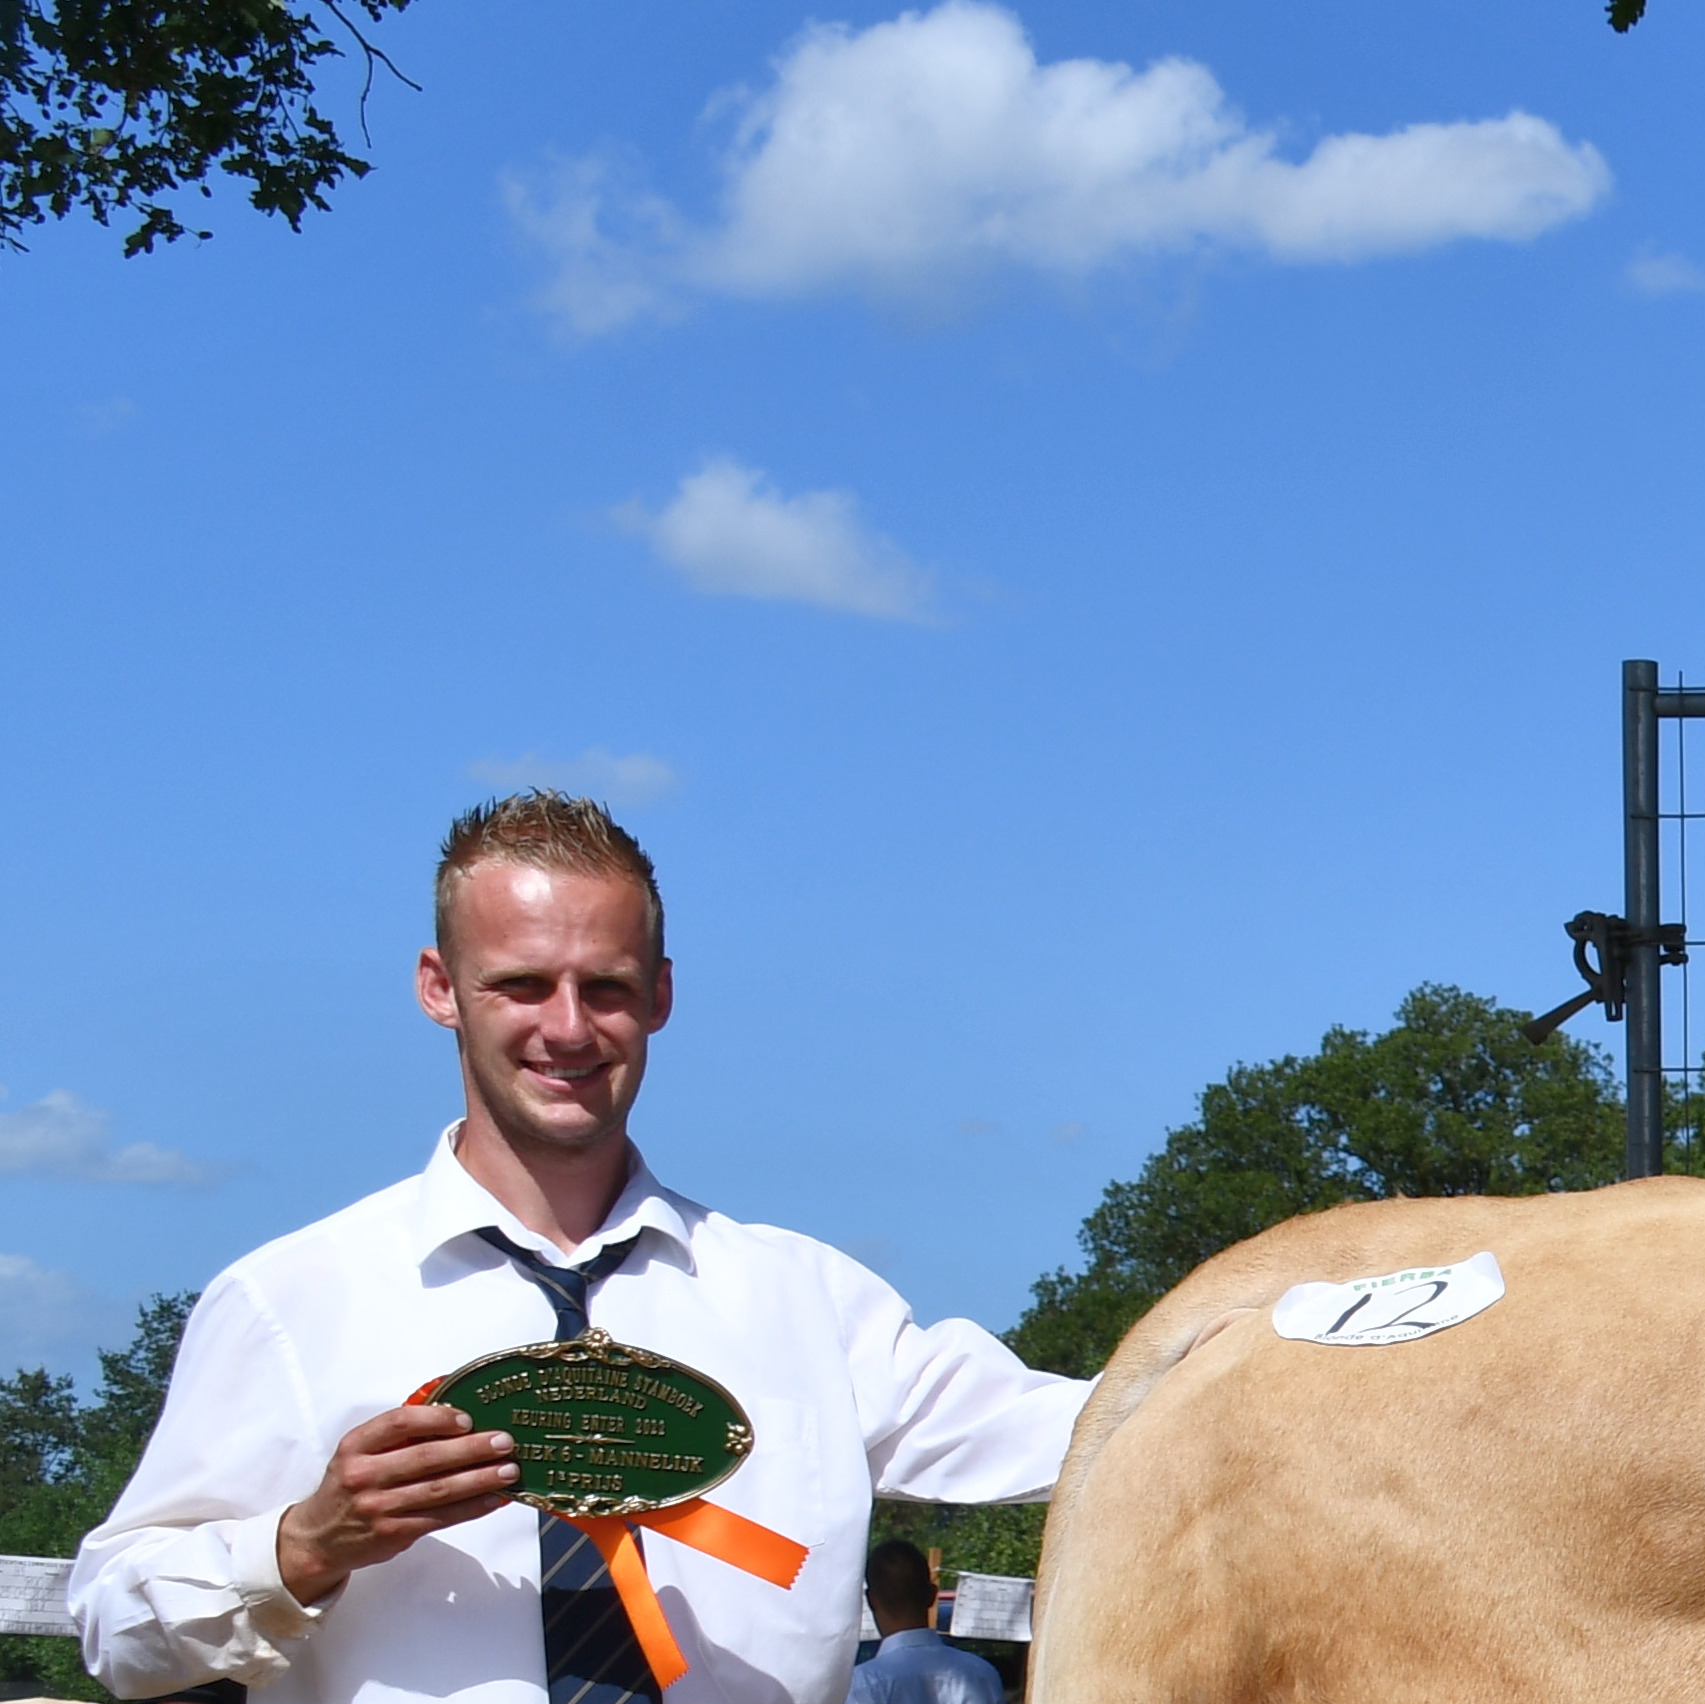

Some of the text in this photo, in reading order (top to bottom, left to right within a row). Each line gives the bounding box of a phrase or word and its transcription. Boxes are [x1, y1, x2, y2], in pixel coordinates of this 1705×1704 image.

[1325, 1280, 1449, 1336] 12
[475, 1366, 705, 1418] BLONDE D'AQUITAINE STAMBOEK
[534, 1385, 648, 1410] NEDERLAND
[511, 1408, 572, 1430] KEURING
[581, 1413, 625, 1433] ENTER
[561, 1445, 573, 1463] 6
[588, 1447, 705, 1474] MANNELIJK
[567, 1471, 624, 1492] PRIJS
